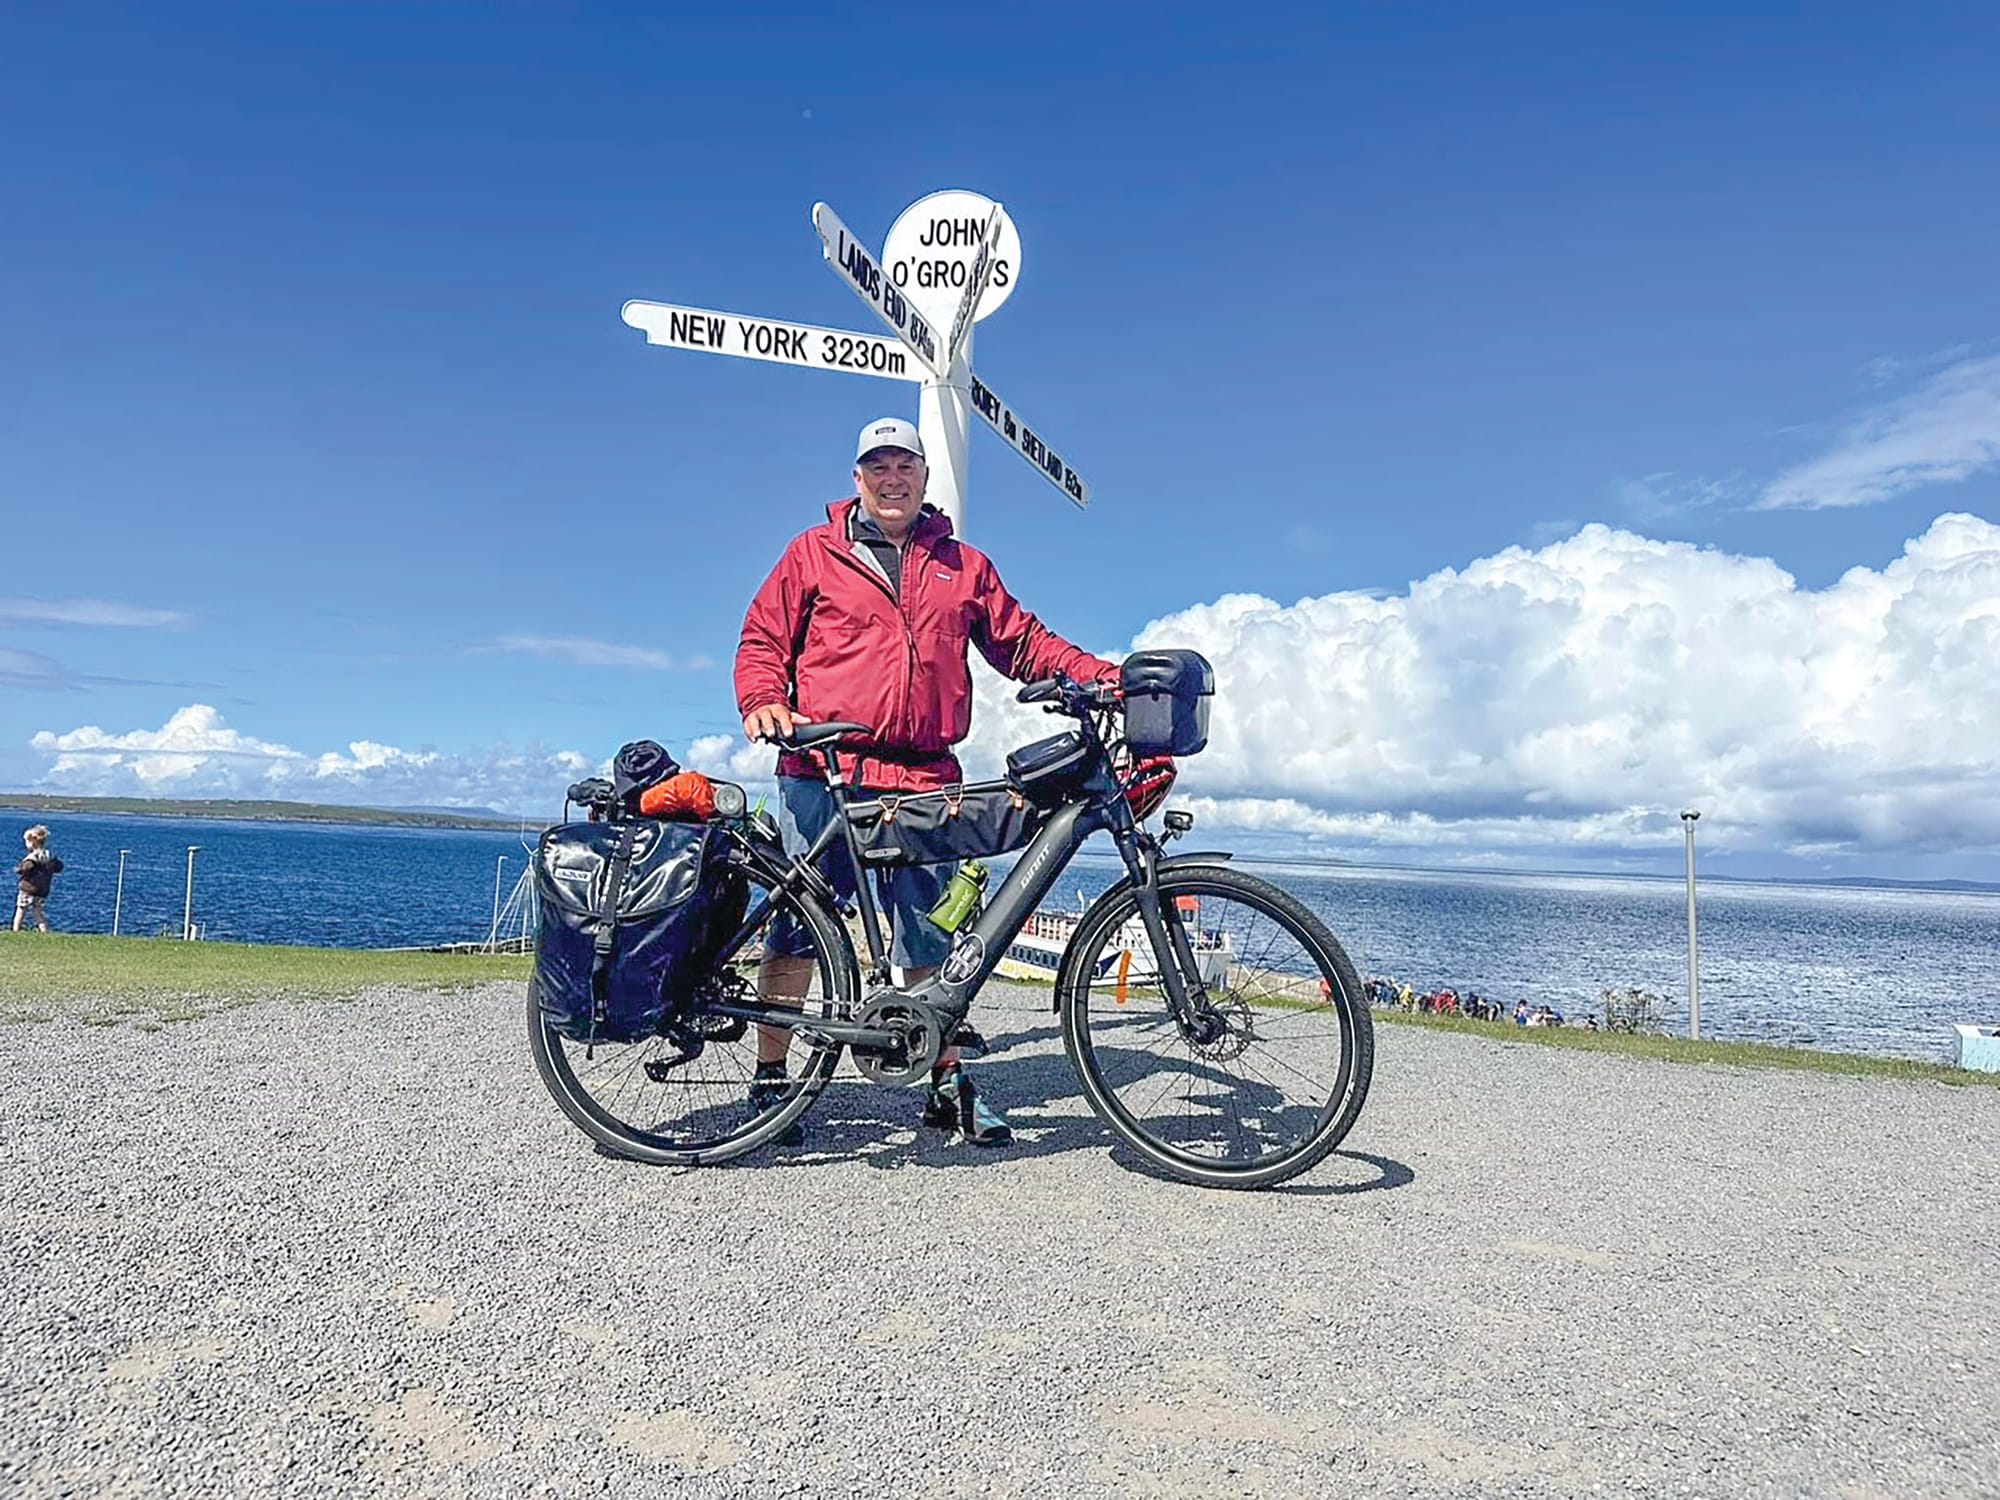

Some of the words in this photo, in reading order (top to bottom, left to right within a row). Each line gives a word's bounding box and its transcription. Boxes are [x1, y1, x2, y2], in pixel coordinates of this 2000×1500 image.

[920, 218, 985, 246] JOHN
[839, 229, 880, 301] LANDS
[884, 281, 906, 329] END
[893, 256, 1008, 288] O'GROS
[670, 311, 726, 348] NEW
[738, 321, 807, 361] YORK
[821, 335, 905, 374] 3230m
[1022, 427, 1063, 481] SHETLAND
